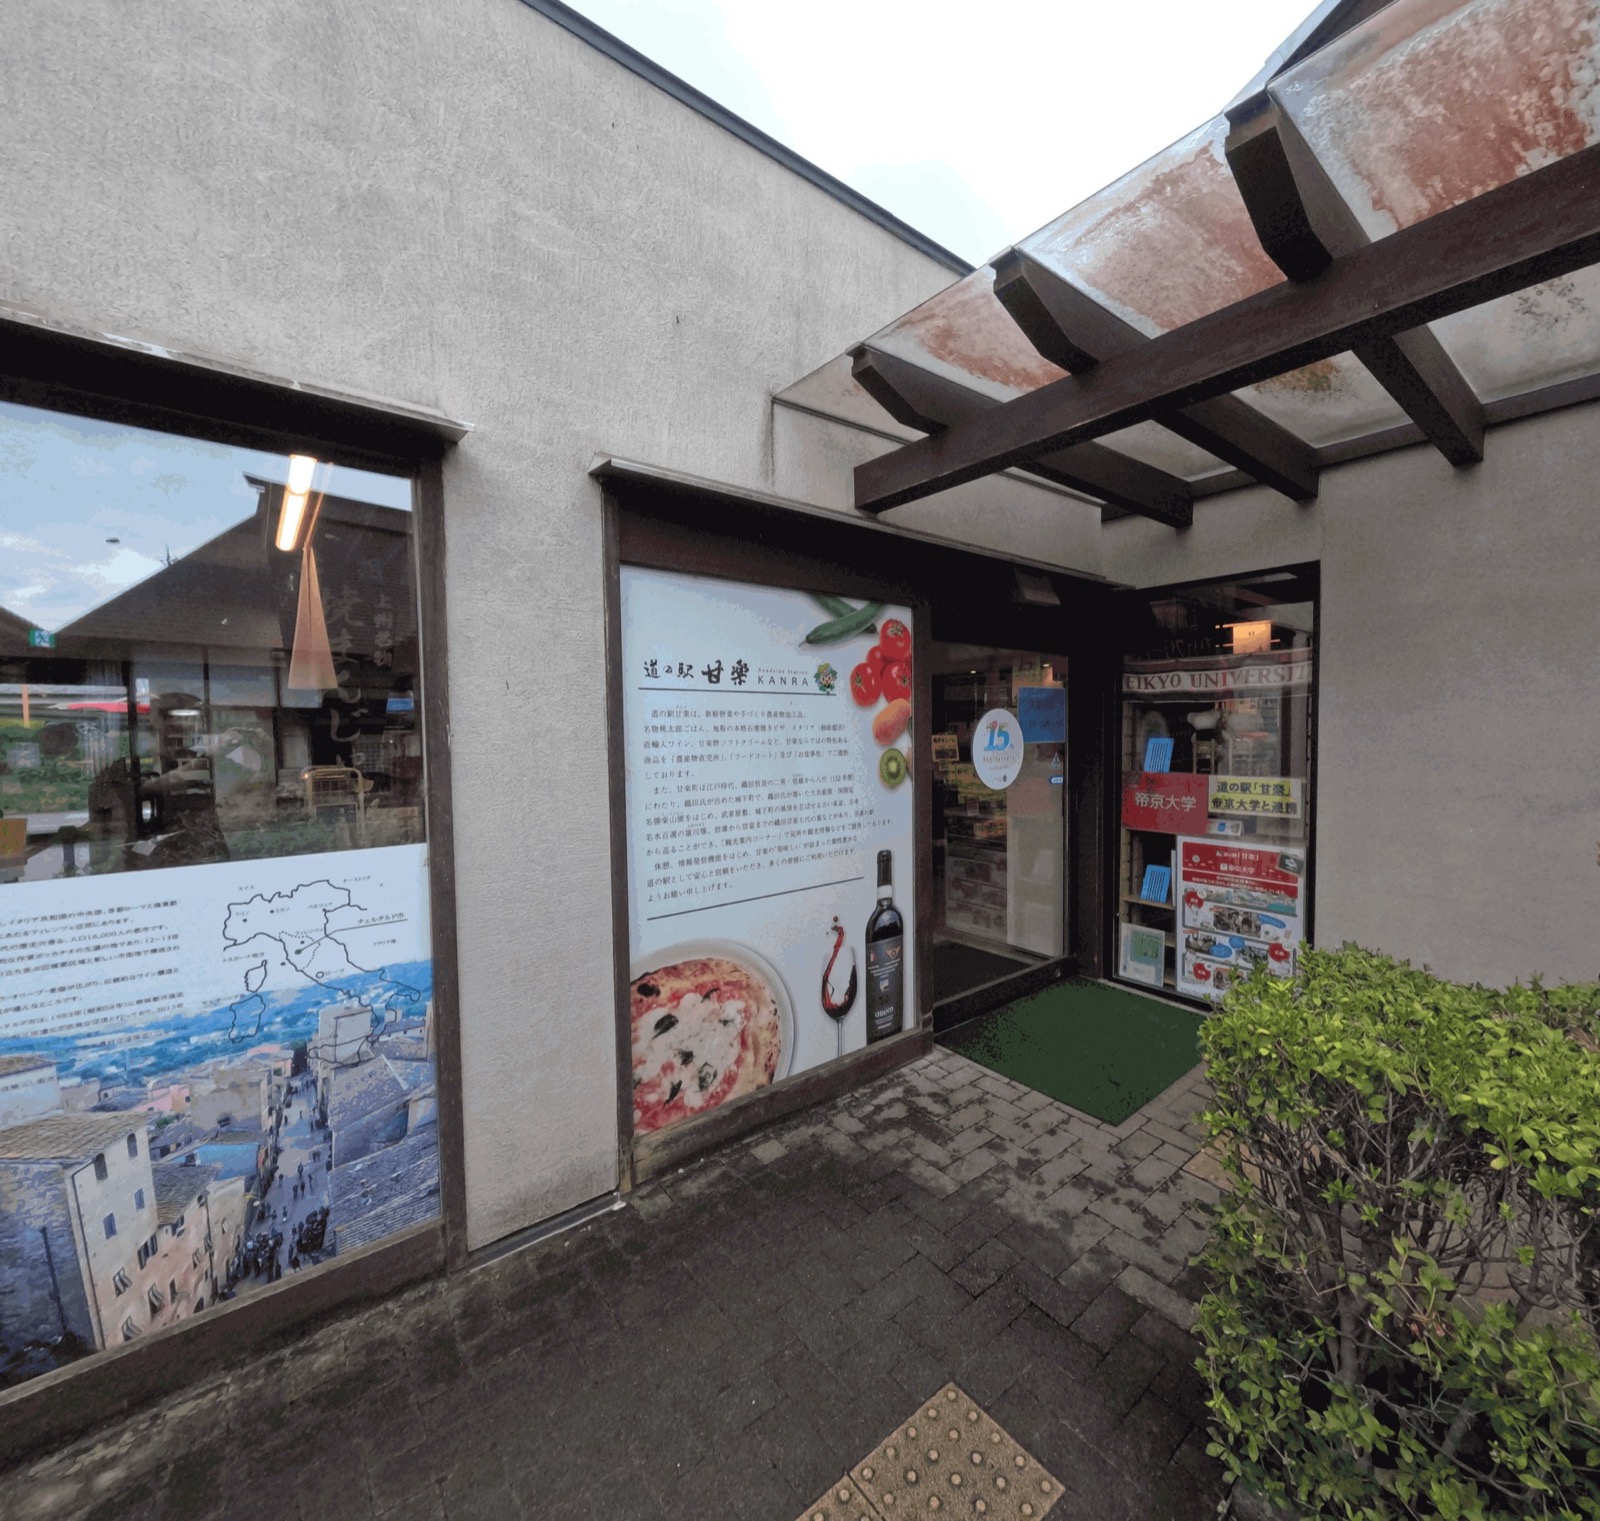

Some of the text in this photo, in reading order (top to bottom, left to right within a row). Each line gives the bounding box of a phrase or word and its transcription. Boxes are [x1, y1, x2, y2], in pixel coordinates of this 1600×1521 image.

[643, 659, 694, 680] 道の駅
[757, 675, 809, 687] KANRA
[645, 768, 696, 780] しております。
[1217, 780, 1291, 796] 道の駅「甘楽」
[1134, 792, 1197, 812] 帝京大学
[1211, 797, 1298, 815] 帝京大学と連携
